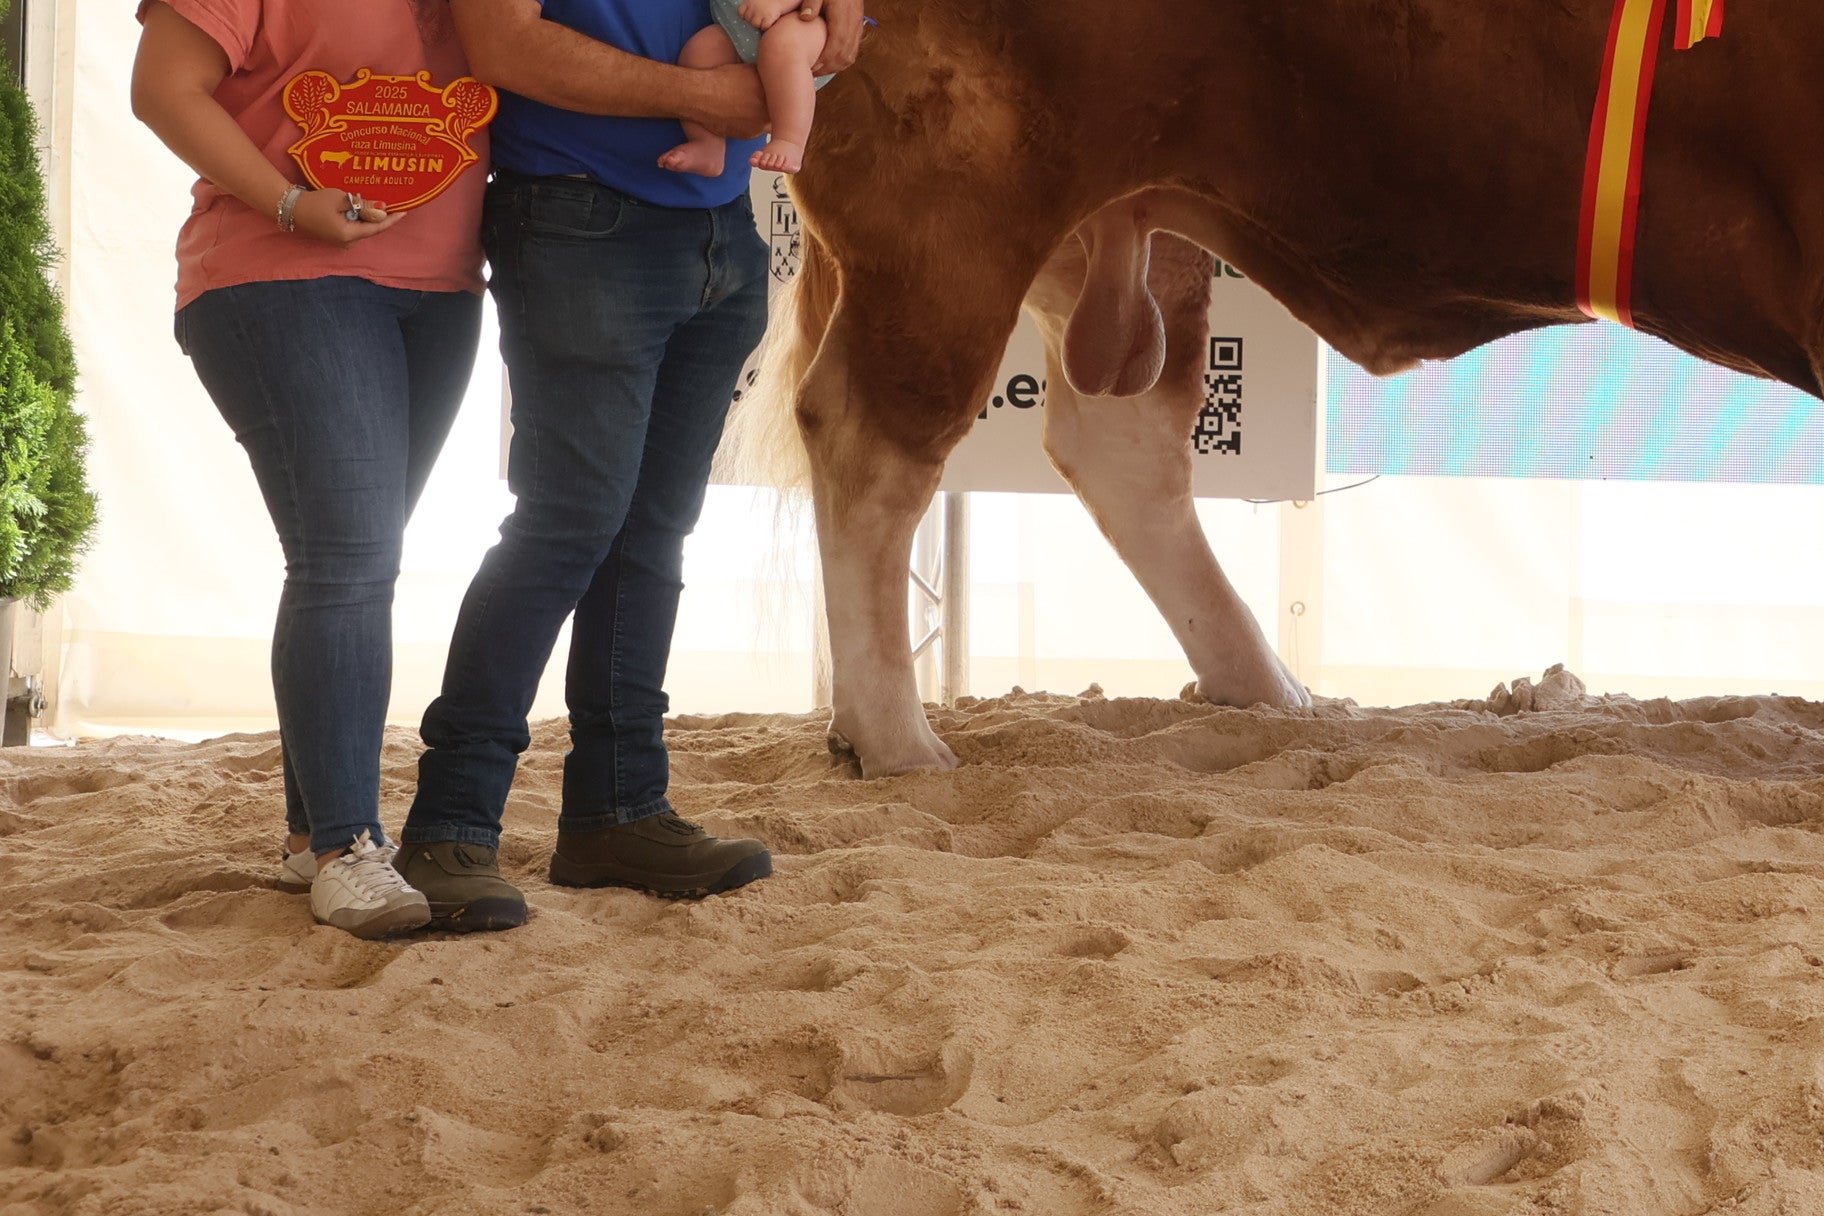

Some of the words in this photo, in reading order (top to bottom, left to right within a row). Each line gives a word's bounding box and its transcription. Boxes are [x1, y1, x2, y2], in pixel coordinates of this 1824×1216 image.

[375, 86, 407, 99] 2025
[346, 101, 430, 117] SALAMANCA
[340, 126, 387, 142] Concurso
[390, 124, 431, 145] Nacional
[351, 141, 370, 149] raza
[373, 140, 416, 151] Limusina
[353, 156, 443, 172] LIMUSIN
[343, 174, 380, 185] CAMPEÓN
[383, 176, 414, 185] ADULTO
